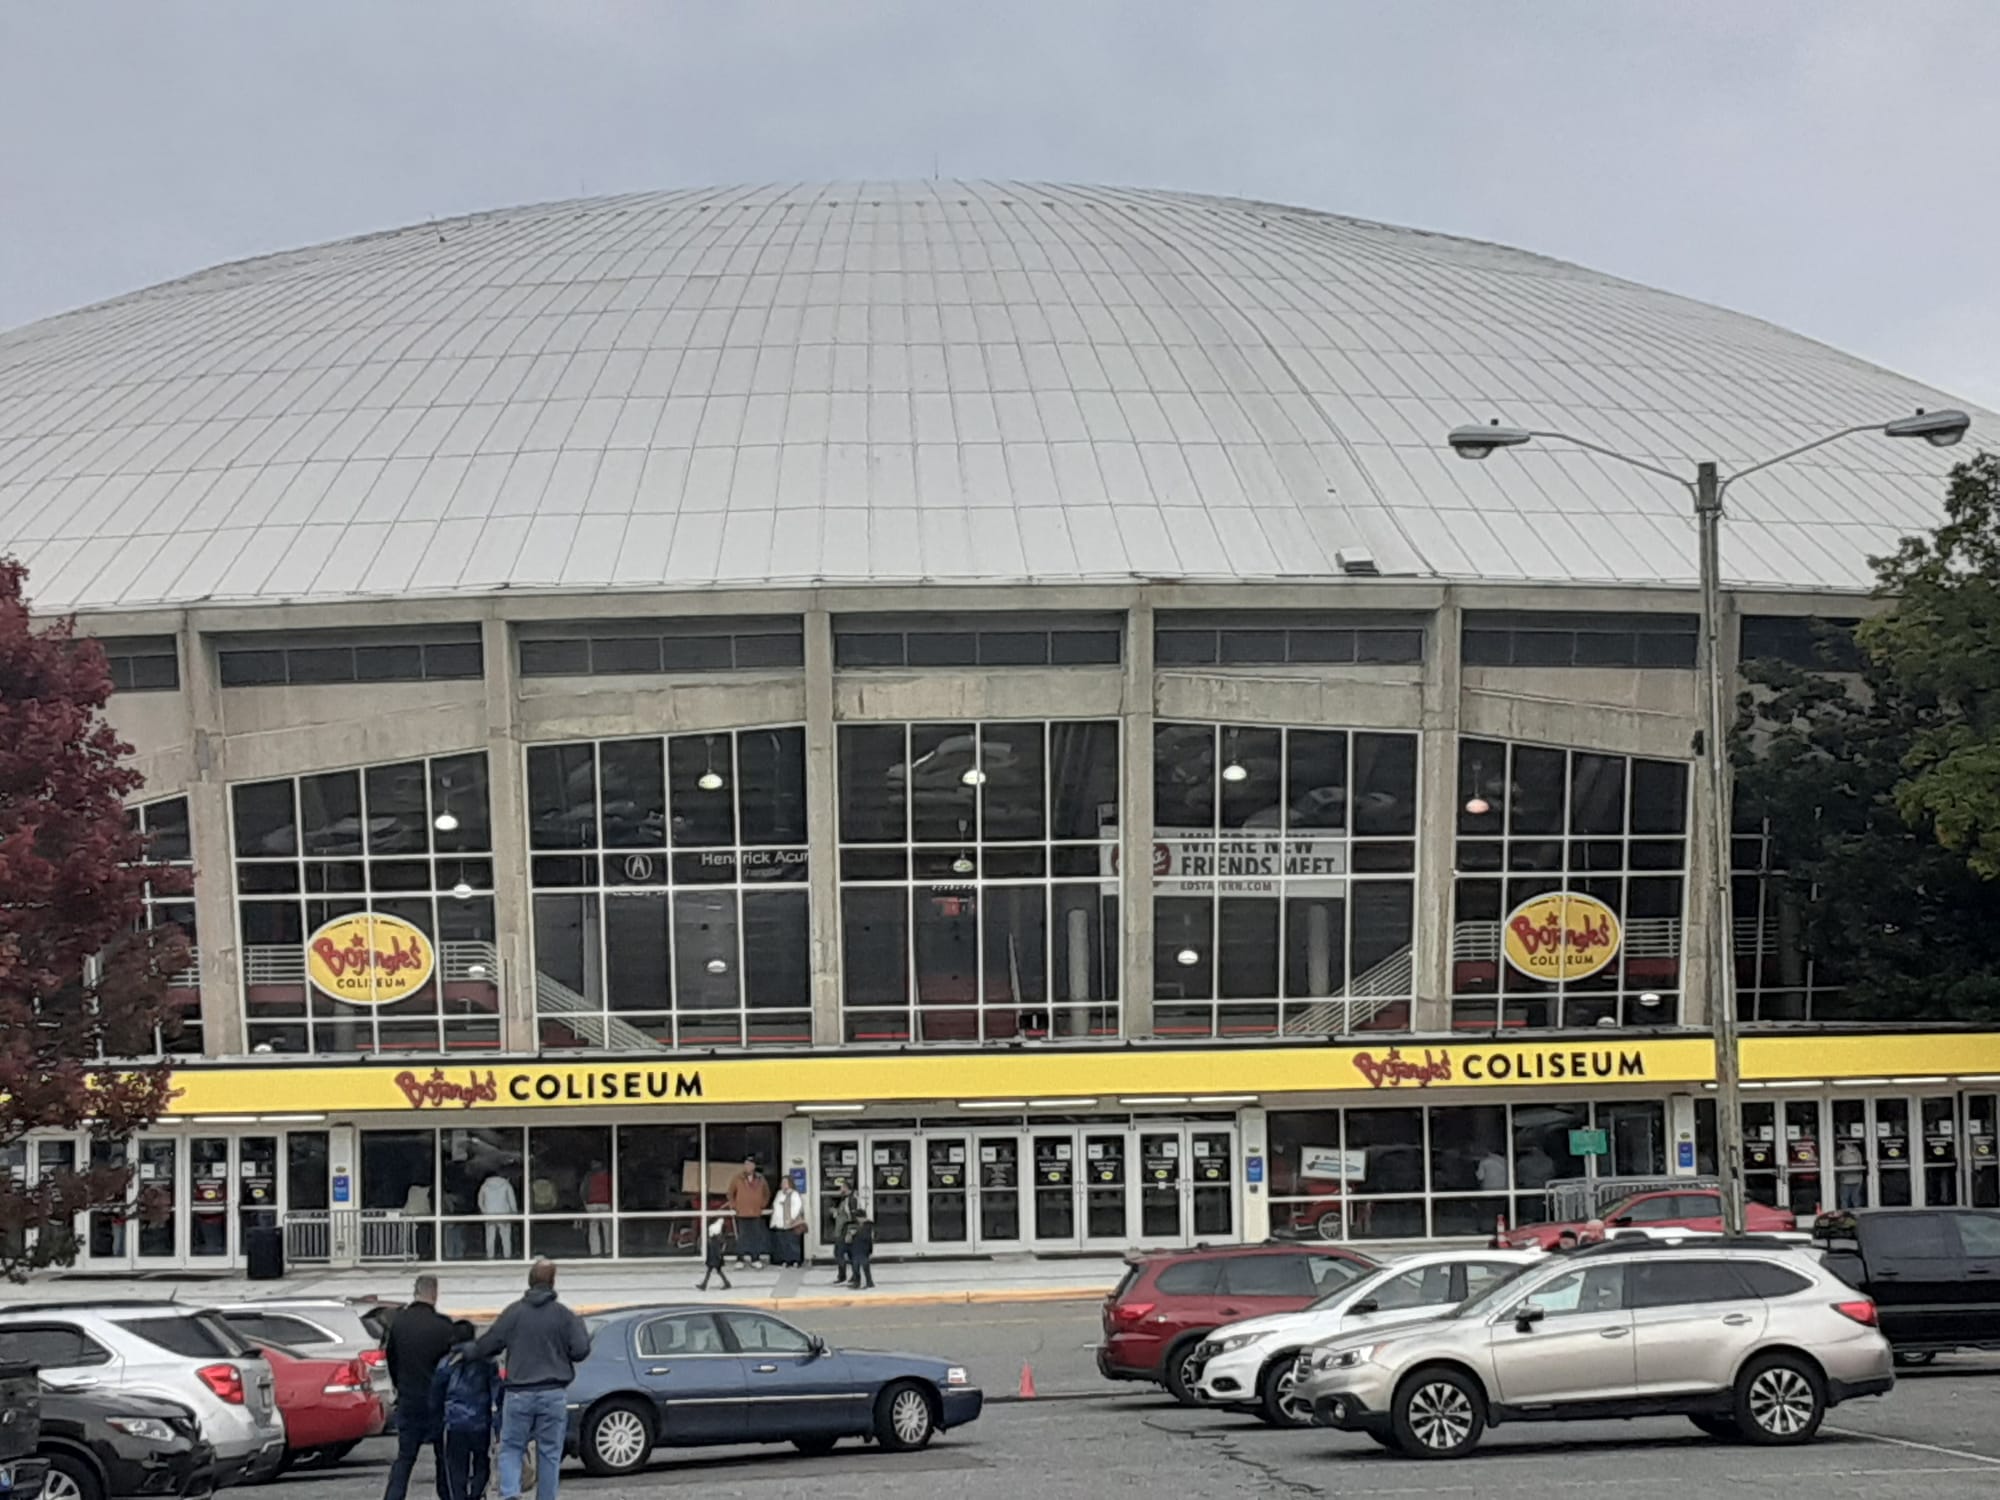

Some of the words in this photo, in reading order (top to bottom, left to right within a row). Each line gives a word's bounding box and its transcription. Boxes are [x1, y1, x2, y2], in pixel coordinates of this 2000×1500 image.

[1180, 832, 1257, 854] WHERE
[1181, 856, 1272, 876] FRIENDS
[1285, 857, 1335, 876] MEET
[1529, 955, 1594, 966] COLIEUM
[336, 978, 406, 989] COLIEUM
[1462, 1050, 1645, 1079] COLISEUM
[508, 1070, 703, 1101] COLISEUM
